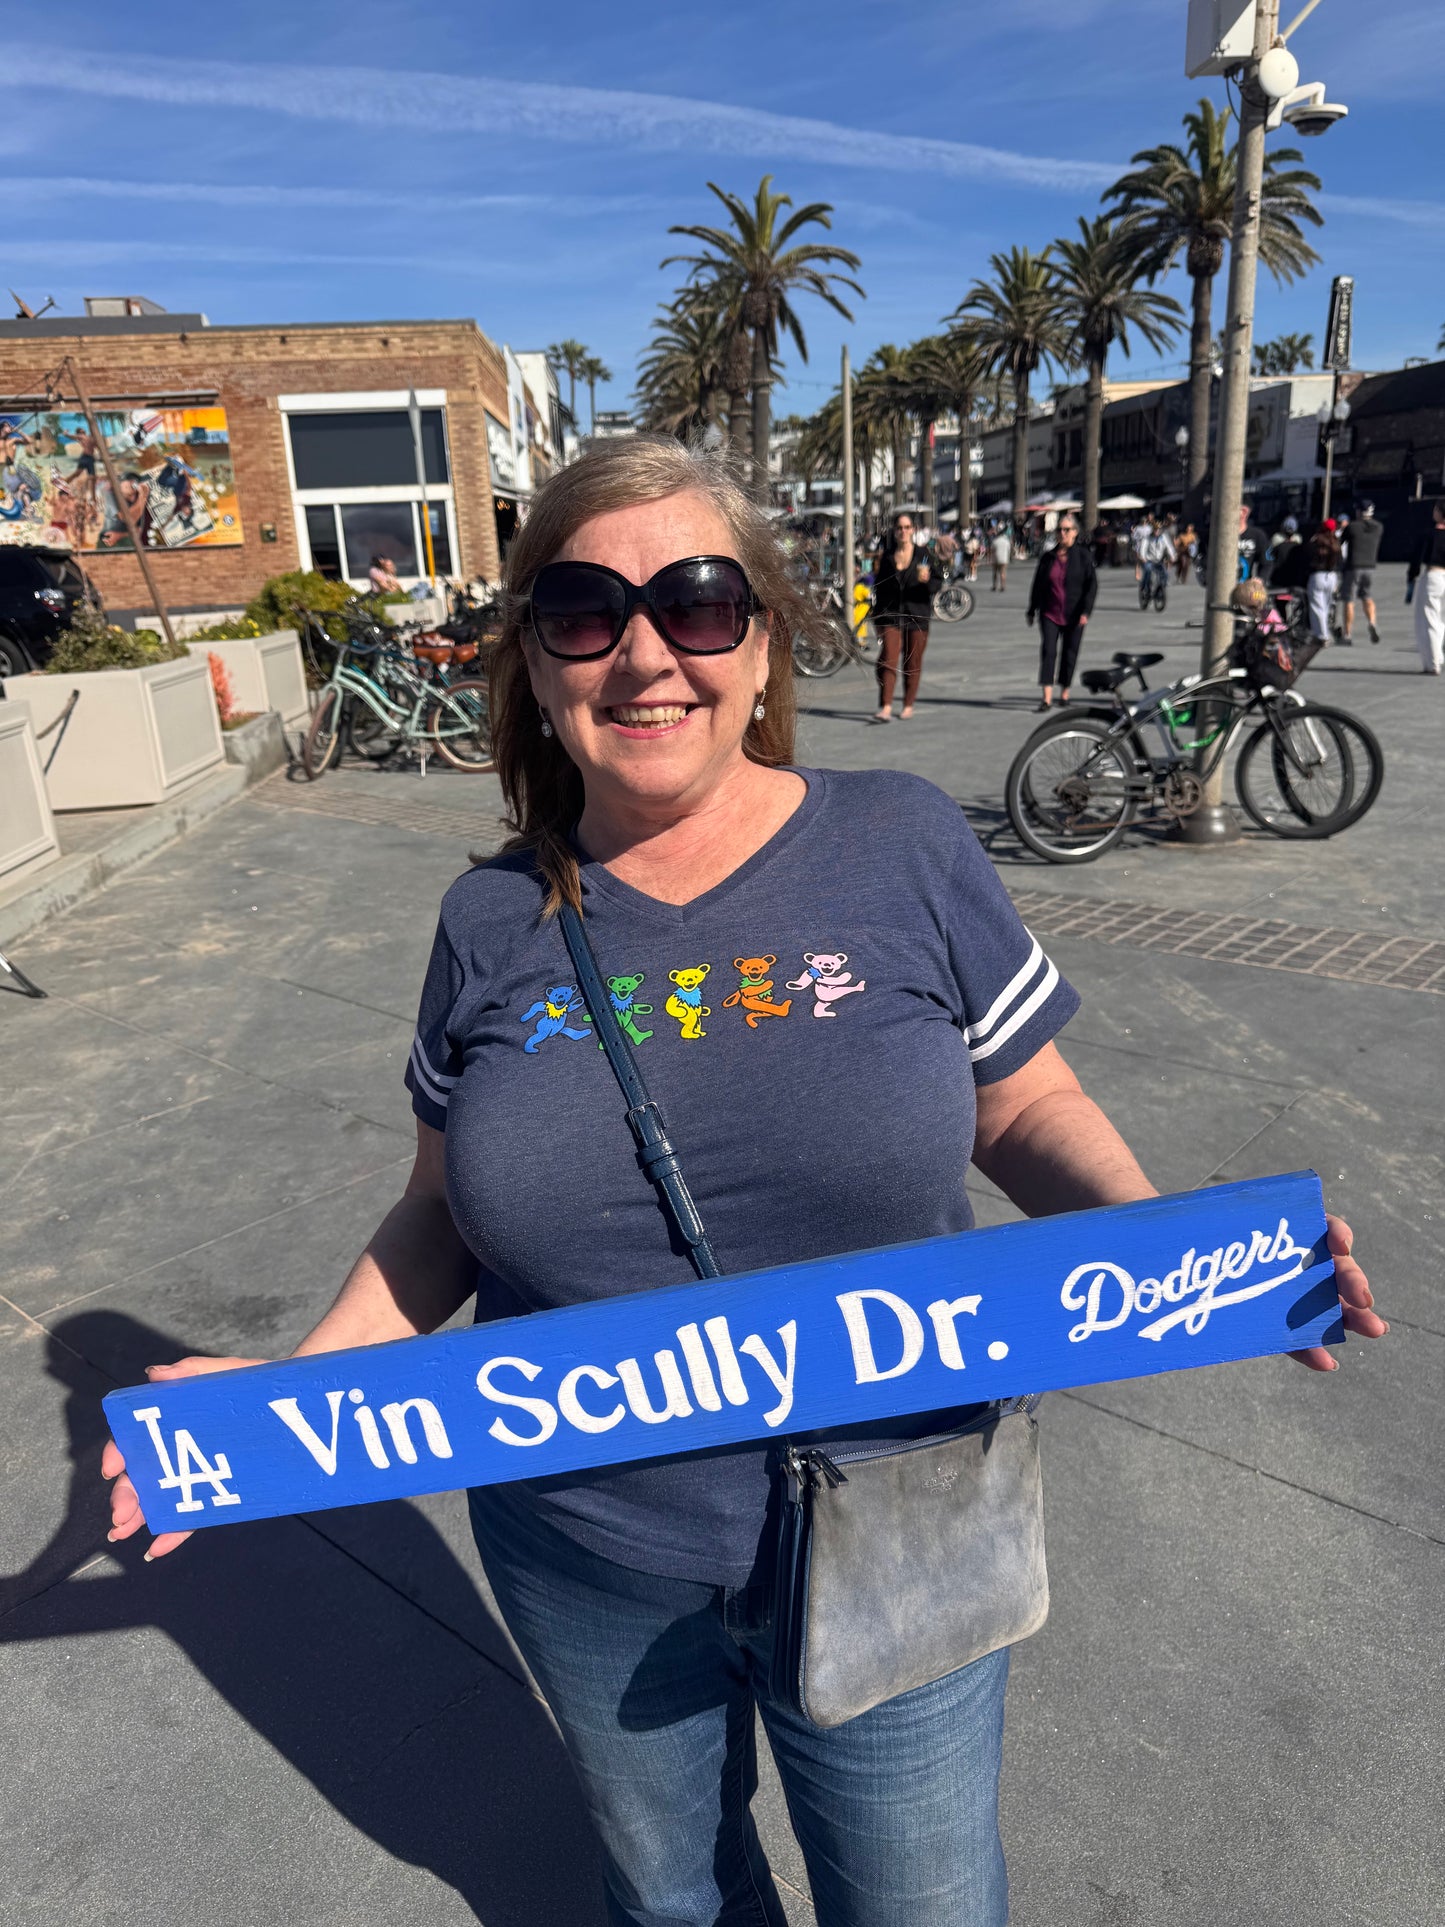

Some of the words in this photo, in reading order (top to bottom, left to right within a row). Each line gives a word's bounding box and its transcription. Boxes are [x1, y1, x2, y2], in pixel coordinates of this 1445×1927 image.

[133, 1406, 242, 1513] LA
[268, 1389, 453, 1475] Vin
[476, 1316, 797, 1447] Scully
[835, 1288, 1009, 1384] Dr.
[1060, 1217, 1314, 1343] Dodgers
